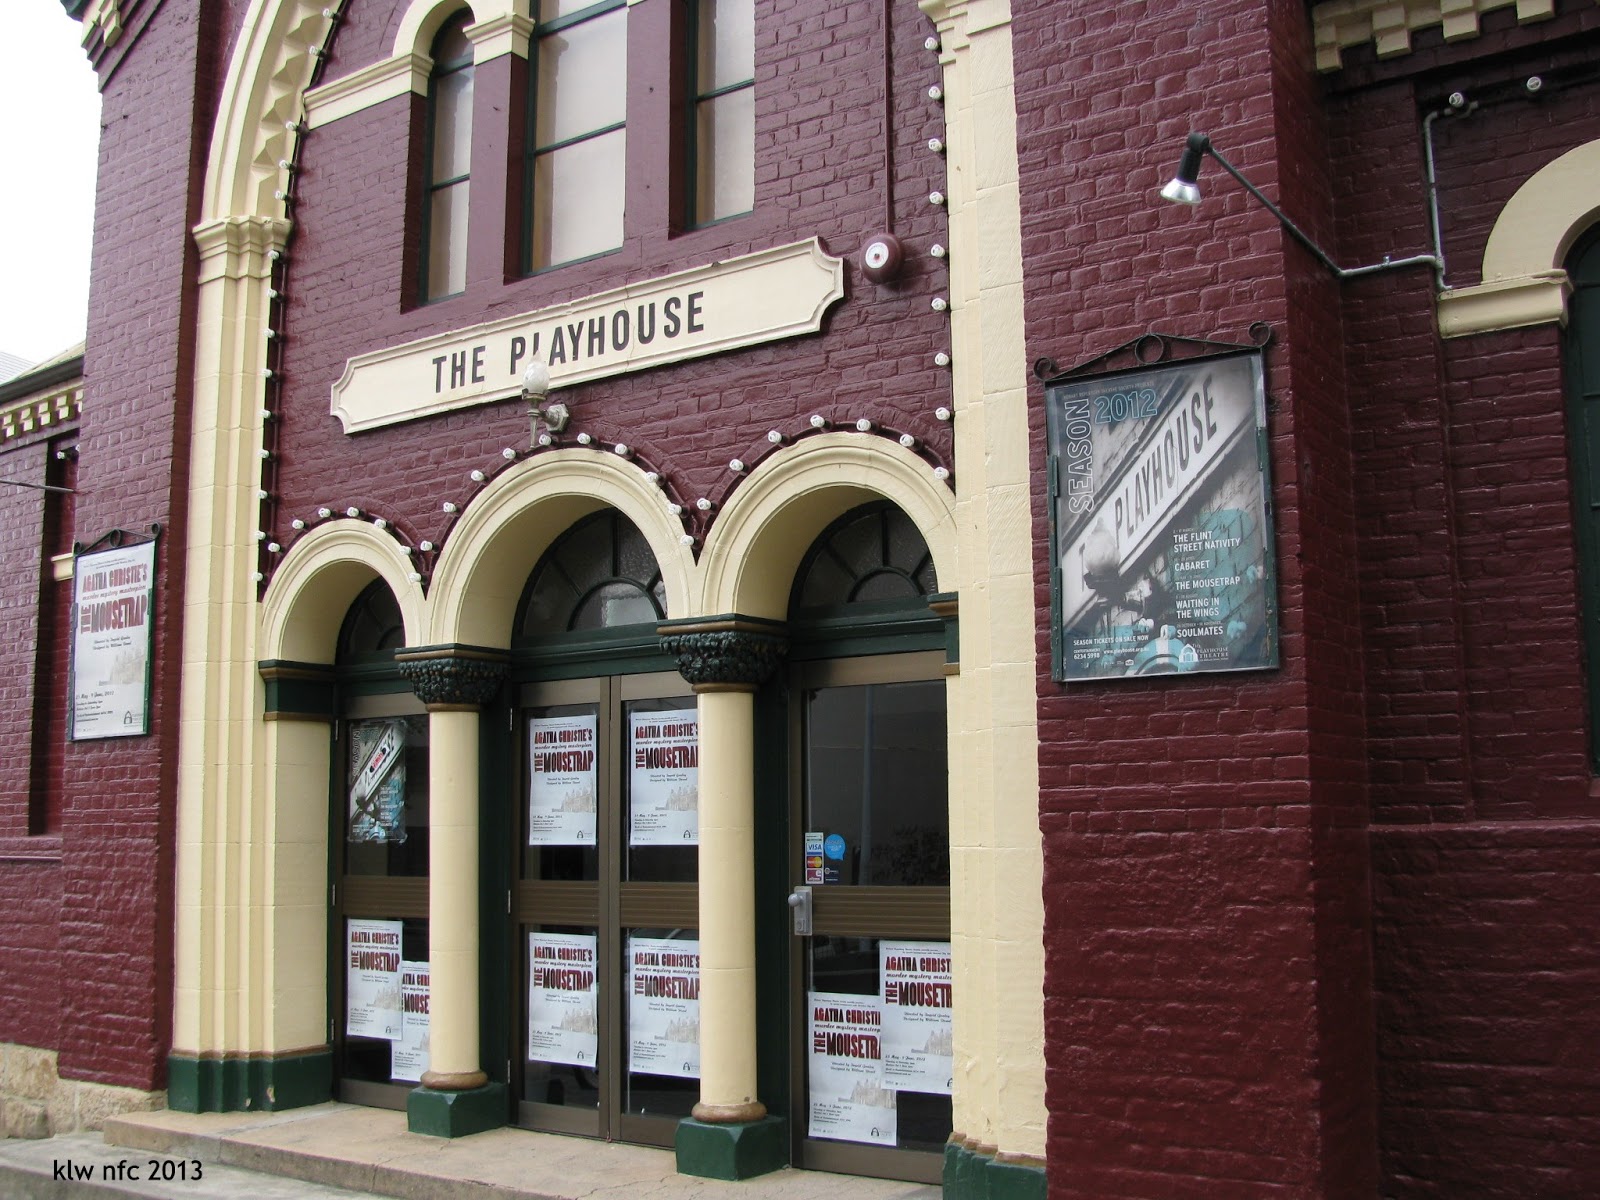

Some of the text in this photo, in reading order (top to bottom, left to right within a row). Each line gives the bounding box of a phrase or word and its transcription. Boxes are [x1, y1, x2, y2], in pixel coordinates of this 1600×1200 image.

[432, 345, 485, 393] THE
[1094, 388, 1158, 425] 2012
[1064, 398, 1094, 514] SEASON
[1114, 373, 1217, 551] PLAYHOUSE
[1173, 533, 1189, 544] THE
[1190, 530, 1213, 542] FLINT
[1173, 537, 1241, 553] STREET NATIVITY
[1174, 559, 1211, 572] CABARET
[82, 571, 108, 593] AGATHA
[1175, 581, 1191, 591] THE
[1192, 575, 1241, 589] MOUSETRAP
[1175, 597, 1220, 609] WAITING IN
[80, 594, 148, 635] THE MOUSETRAP
[1176, 607, 1220, 619] THE WINGS
[1176, 625, 1224, 638] SOULMATES
[1094, 637, 1114, 645] TICKETS
[534, 728, 593, 744] AGATHA CHRISTIE'S
[635, 725, 661, 739] AGATHA
[534, 750, 594, 774] THE MOUSETRAP
[635, 747, 645, 769] THE
[808, 843, 822, 851] VISA
[351, 931, 371, 944] AGATHA
[534, 945, 556, 960] AGATHA
[634, 952, 660, 966] AGATHA
[351, 950, 400, 973] THE MOUSETRAP
[885, 956, 952, 973] AGATHA CHRIST
[402, 973, 416, 986] ATHA
[533, 967, 594, 993] THE MOUSETRAP
[634, 974, 644, 996] THE
[885, 980, 952, 1009] THE MOUSETR
[404, 992, 429, 1015] MOUSE
[813, 1006, 881, 1026] AGATHA CHRISTI
[813, 1030, 881, 1060] THE MOUSETR
